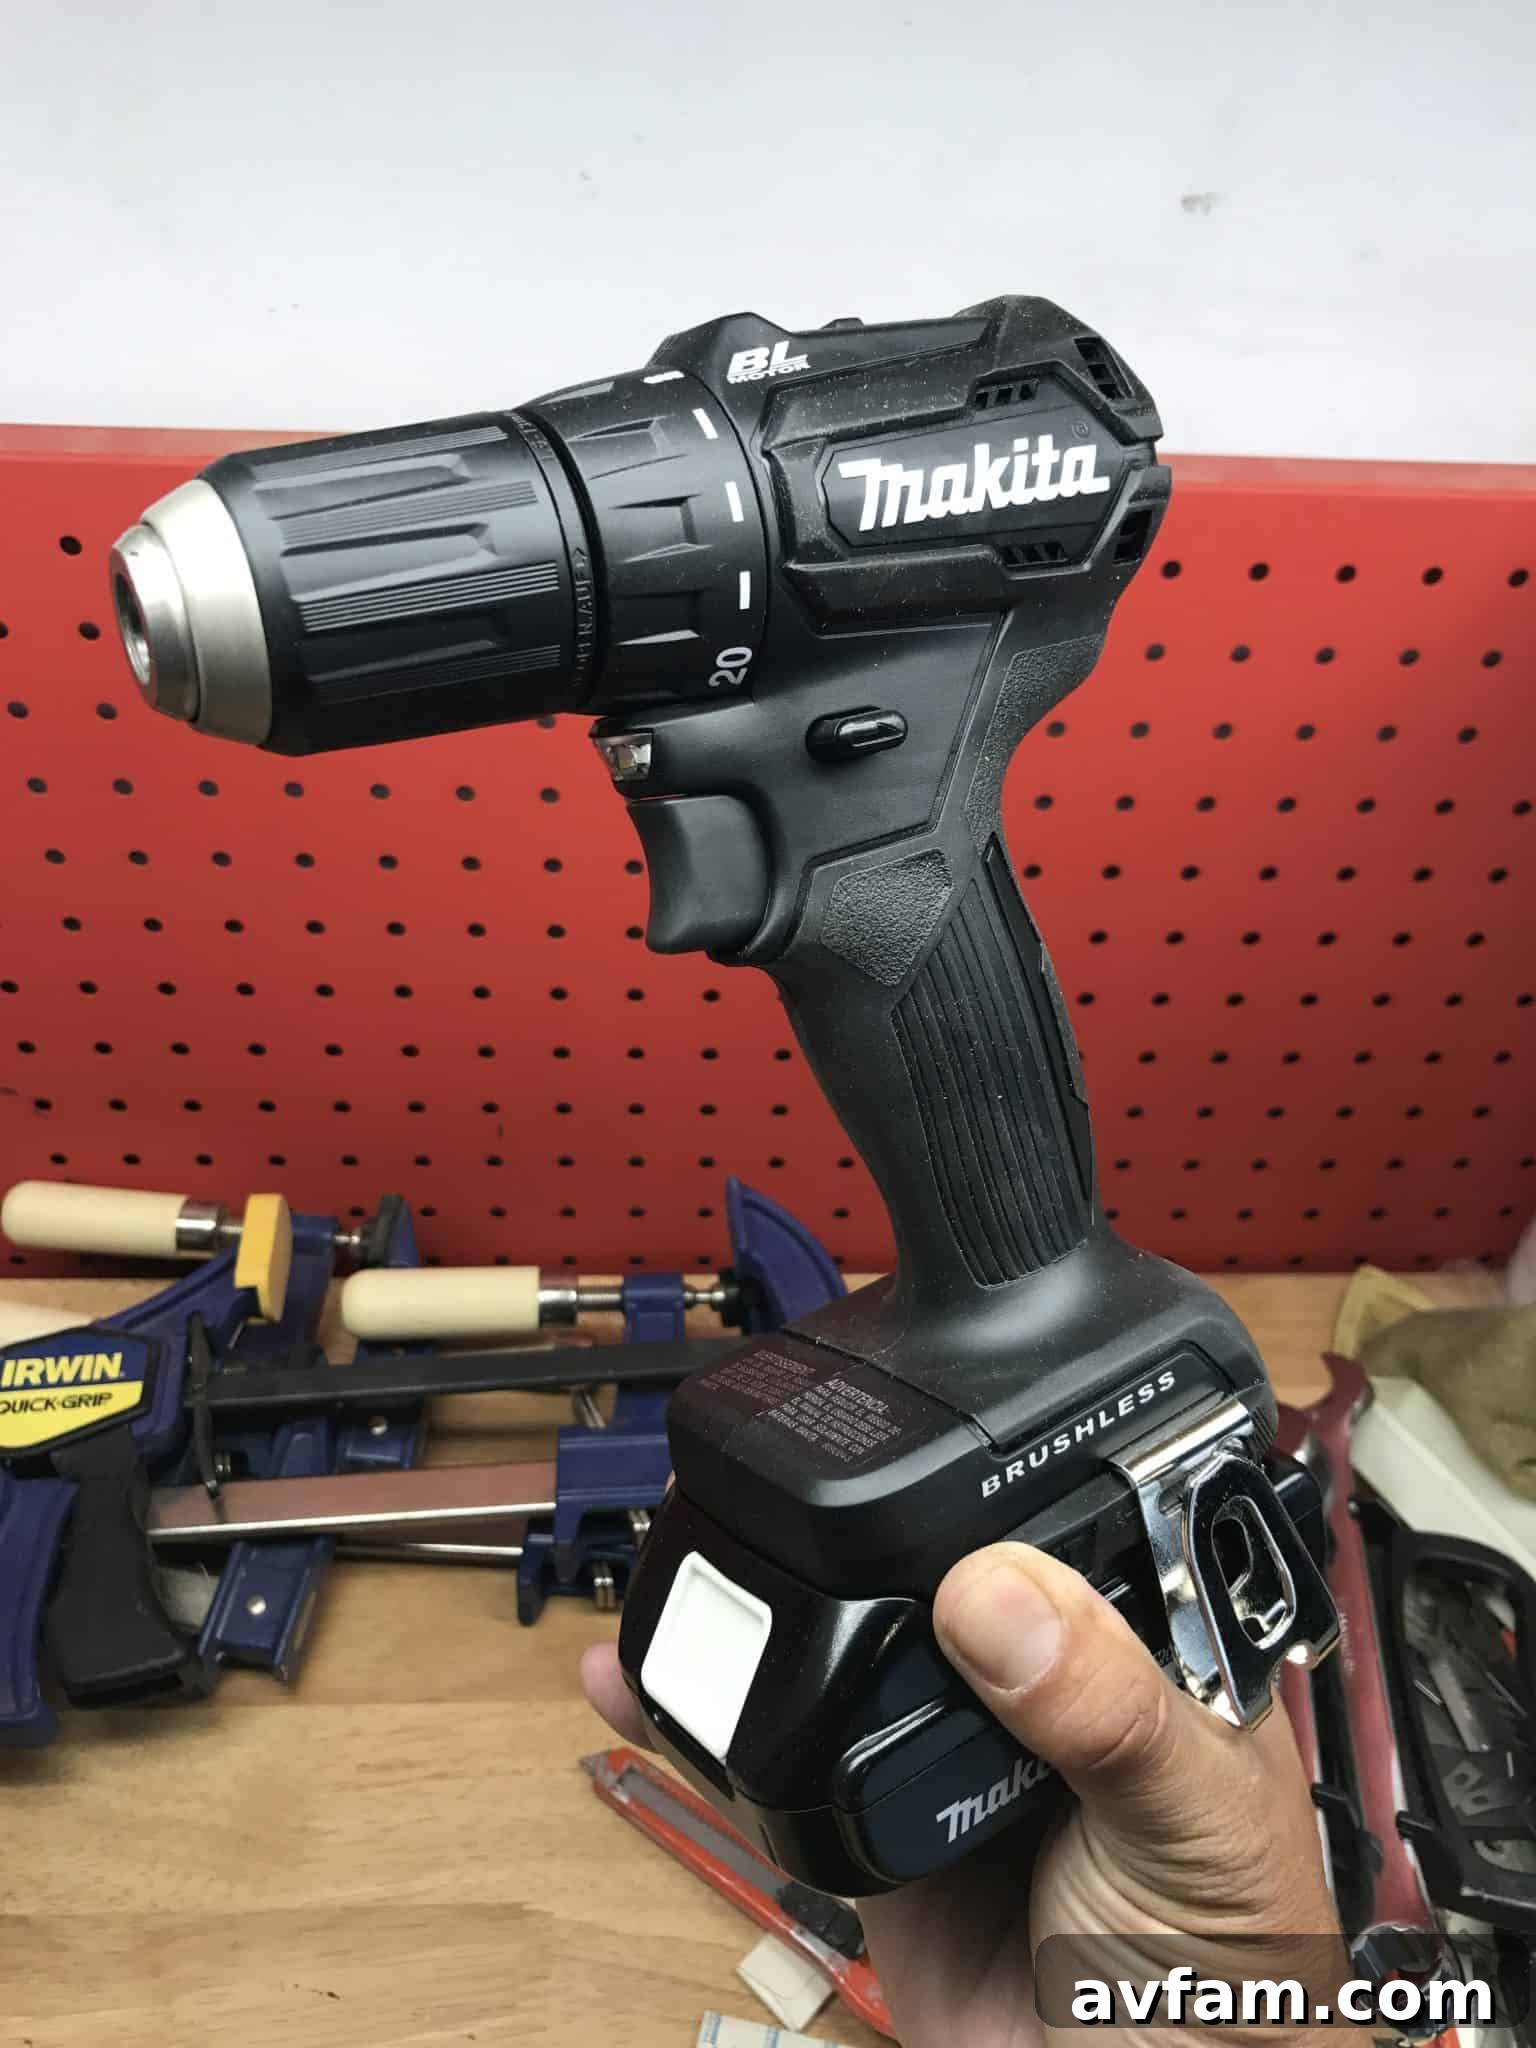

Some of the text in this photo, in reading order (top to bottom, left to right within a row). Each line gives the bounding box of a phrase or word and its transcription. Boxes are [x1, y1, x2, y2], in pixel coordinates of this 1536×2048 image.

[727, 361, 811, 384] MOTOR
[728, 341, 808, 376] BL
[838, 434, 1110, 531] Makita
[708, 646, 753, 687] 20
[0, 1352, 122, 1389] IRWIN
[981, 1371, 1175, 1498] BRUSHLESS
